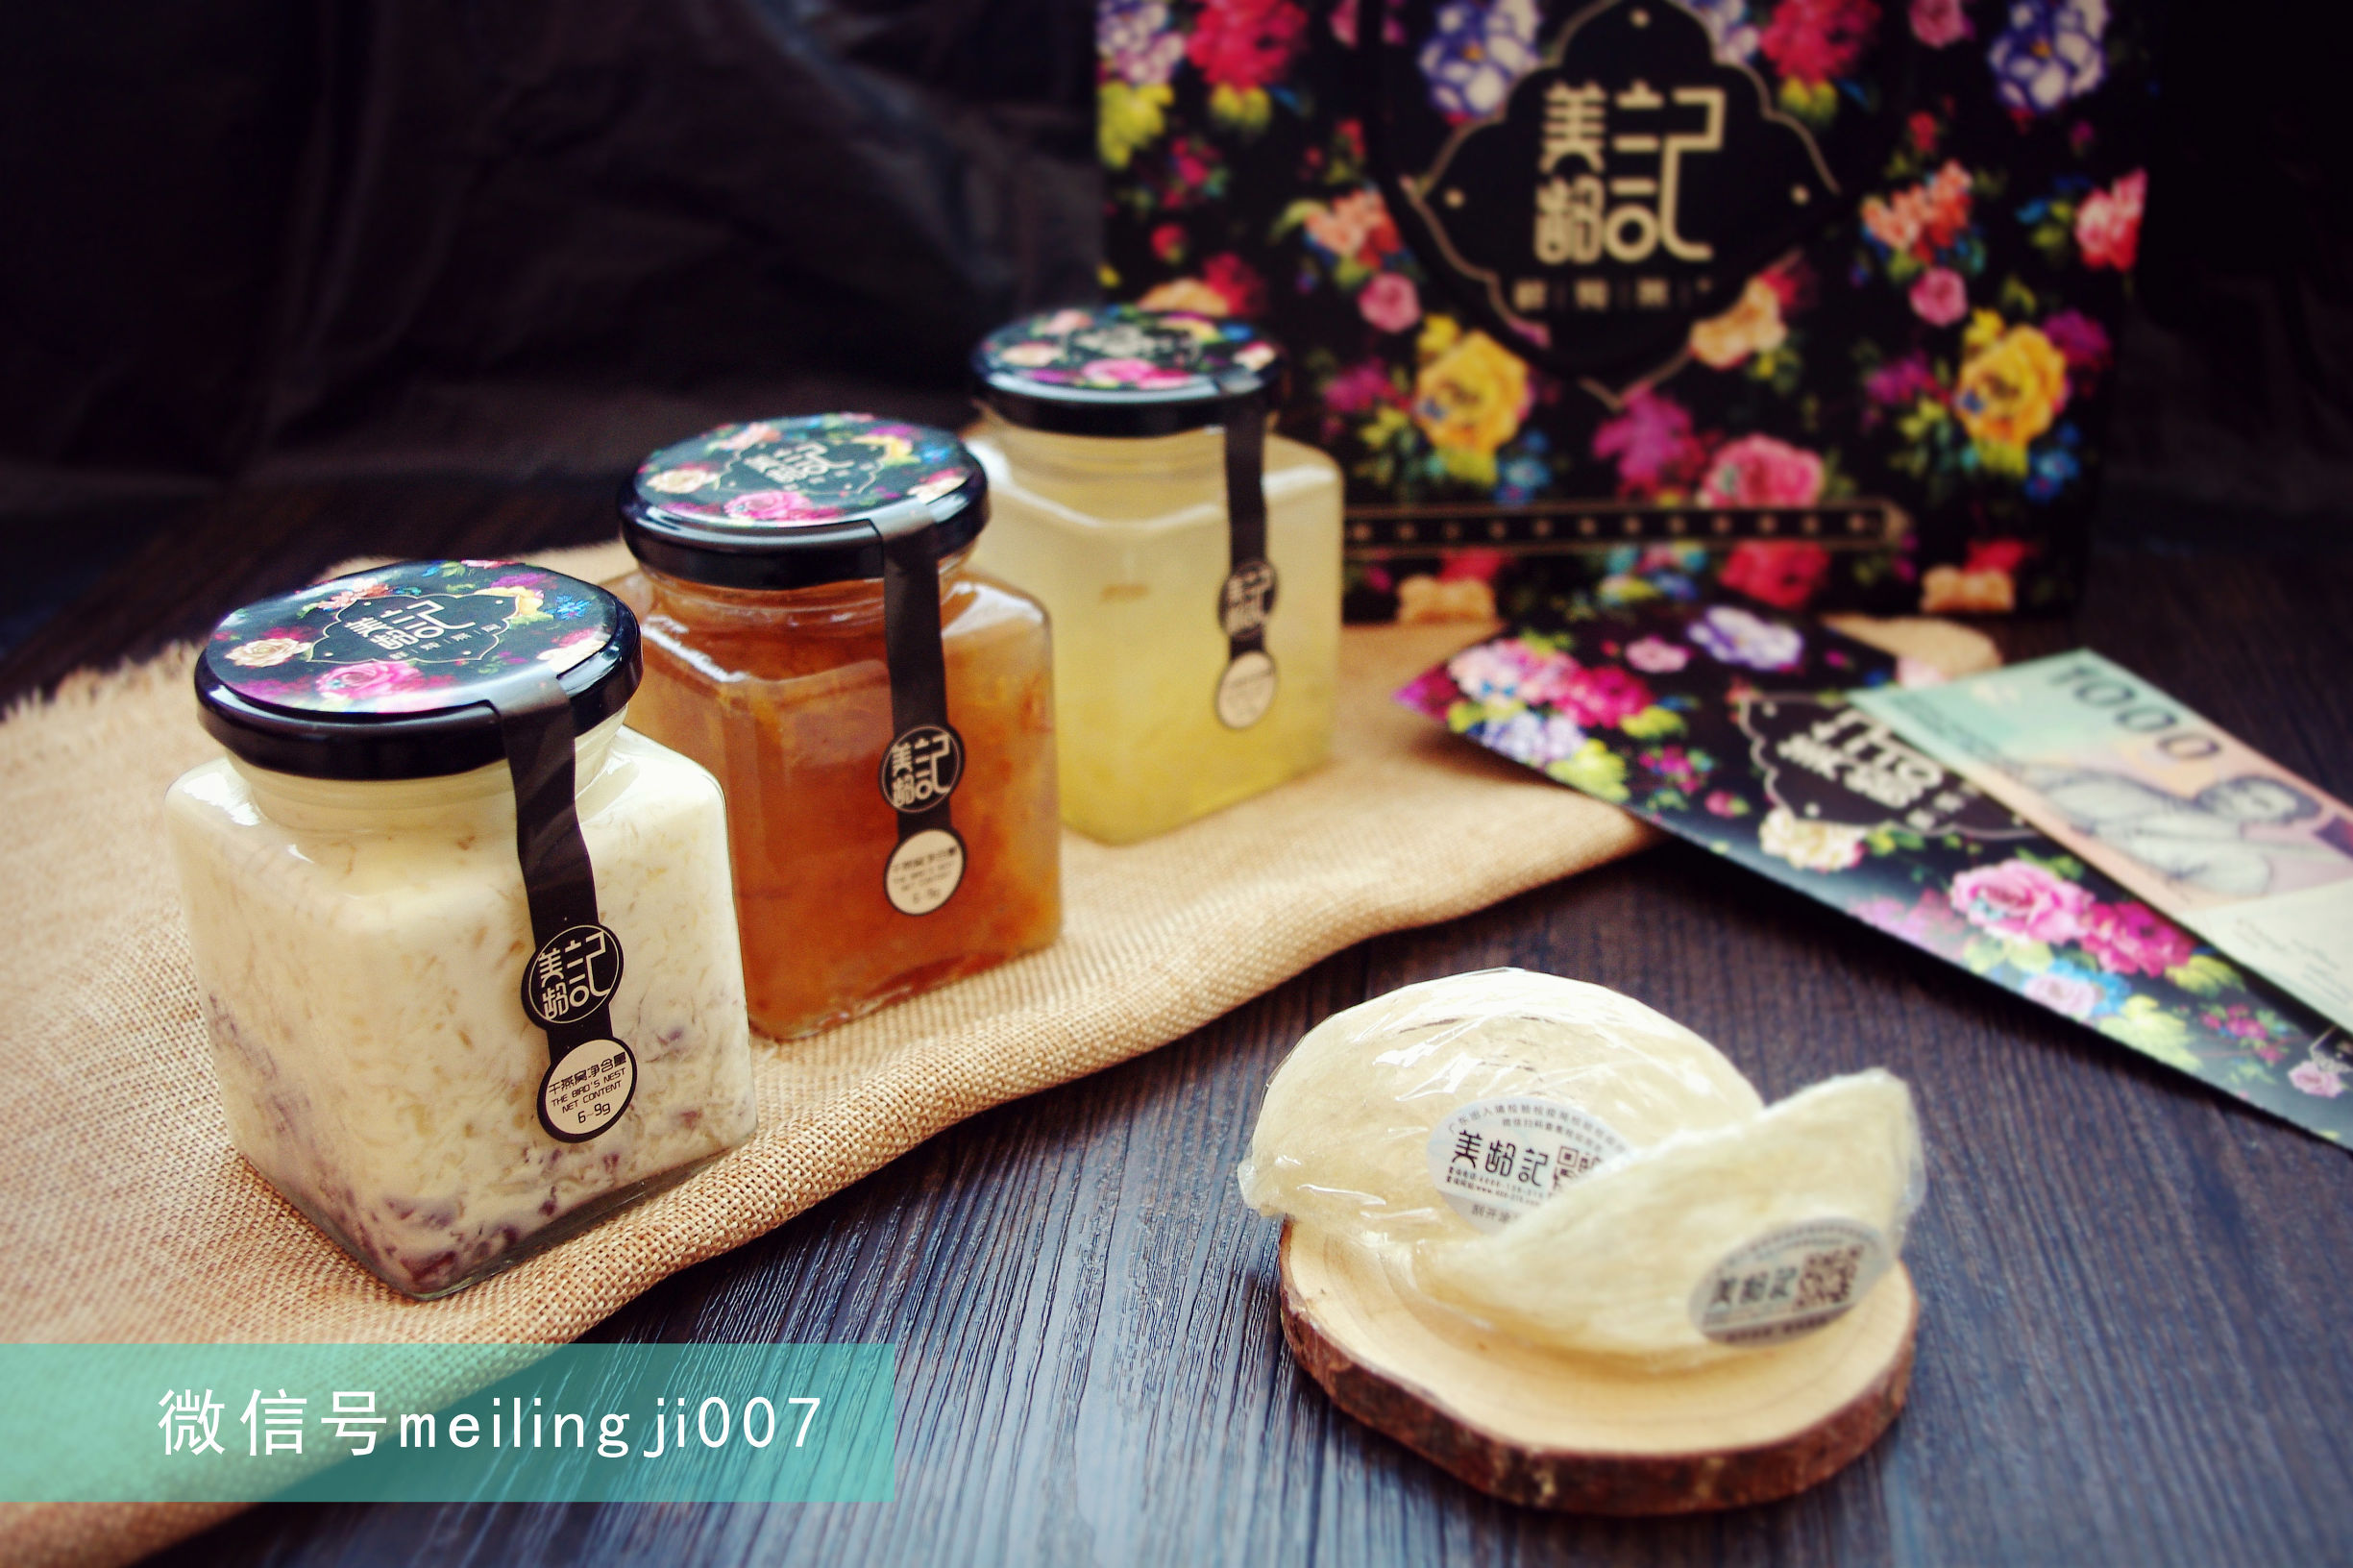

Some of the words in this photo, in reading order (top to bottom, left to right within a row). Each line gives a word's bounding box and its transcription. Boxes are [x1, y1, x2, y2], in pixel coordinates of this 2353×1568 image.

[551, 1094, 568, 1107] THE
[603, 1067, 625, 1084] NEST
[562, 1100, 578, 1114] NET
[582, 1081, 622, 1104] CONTENT
